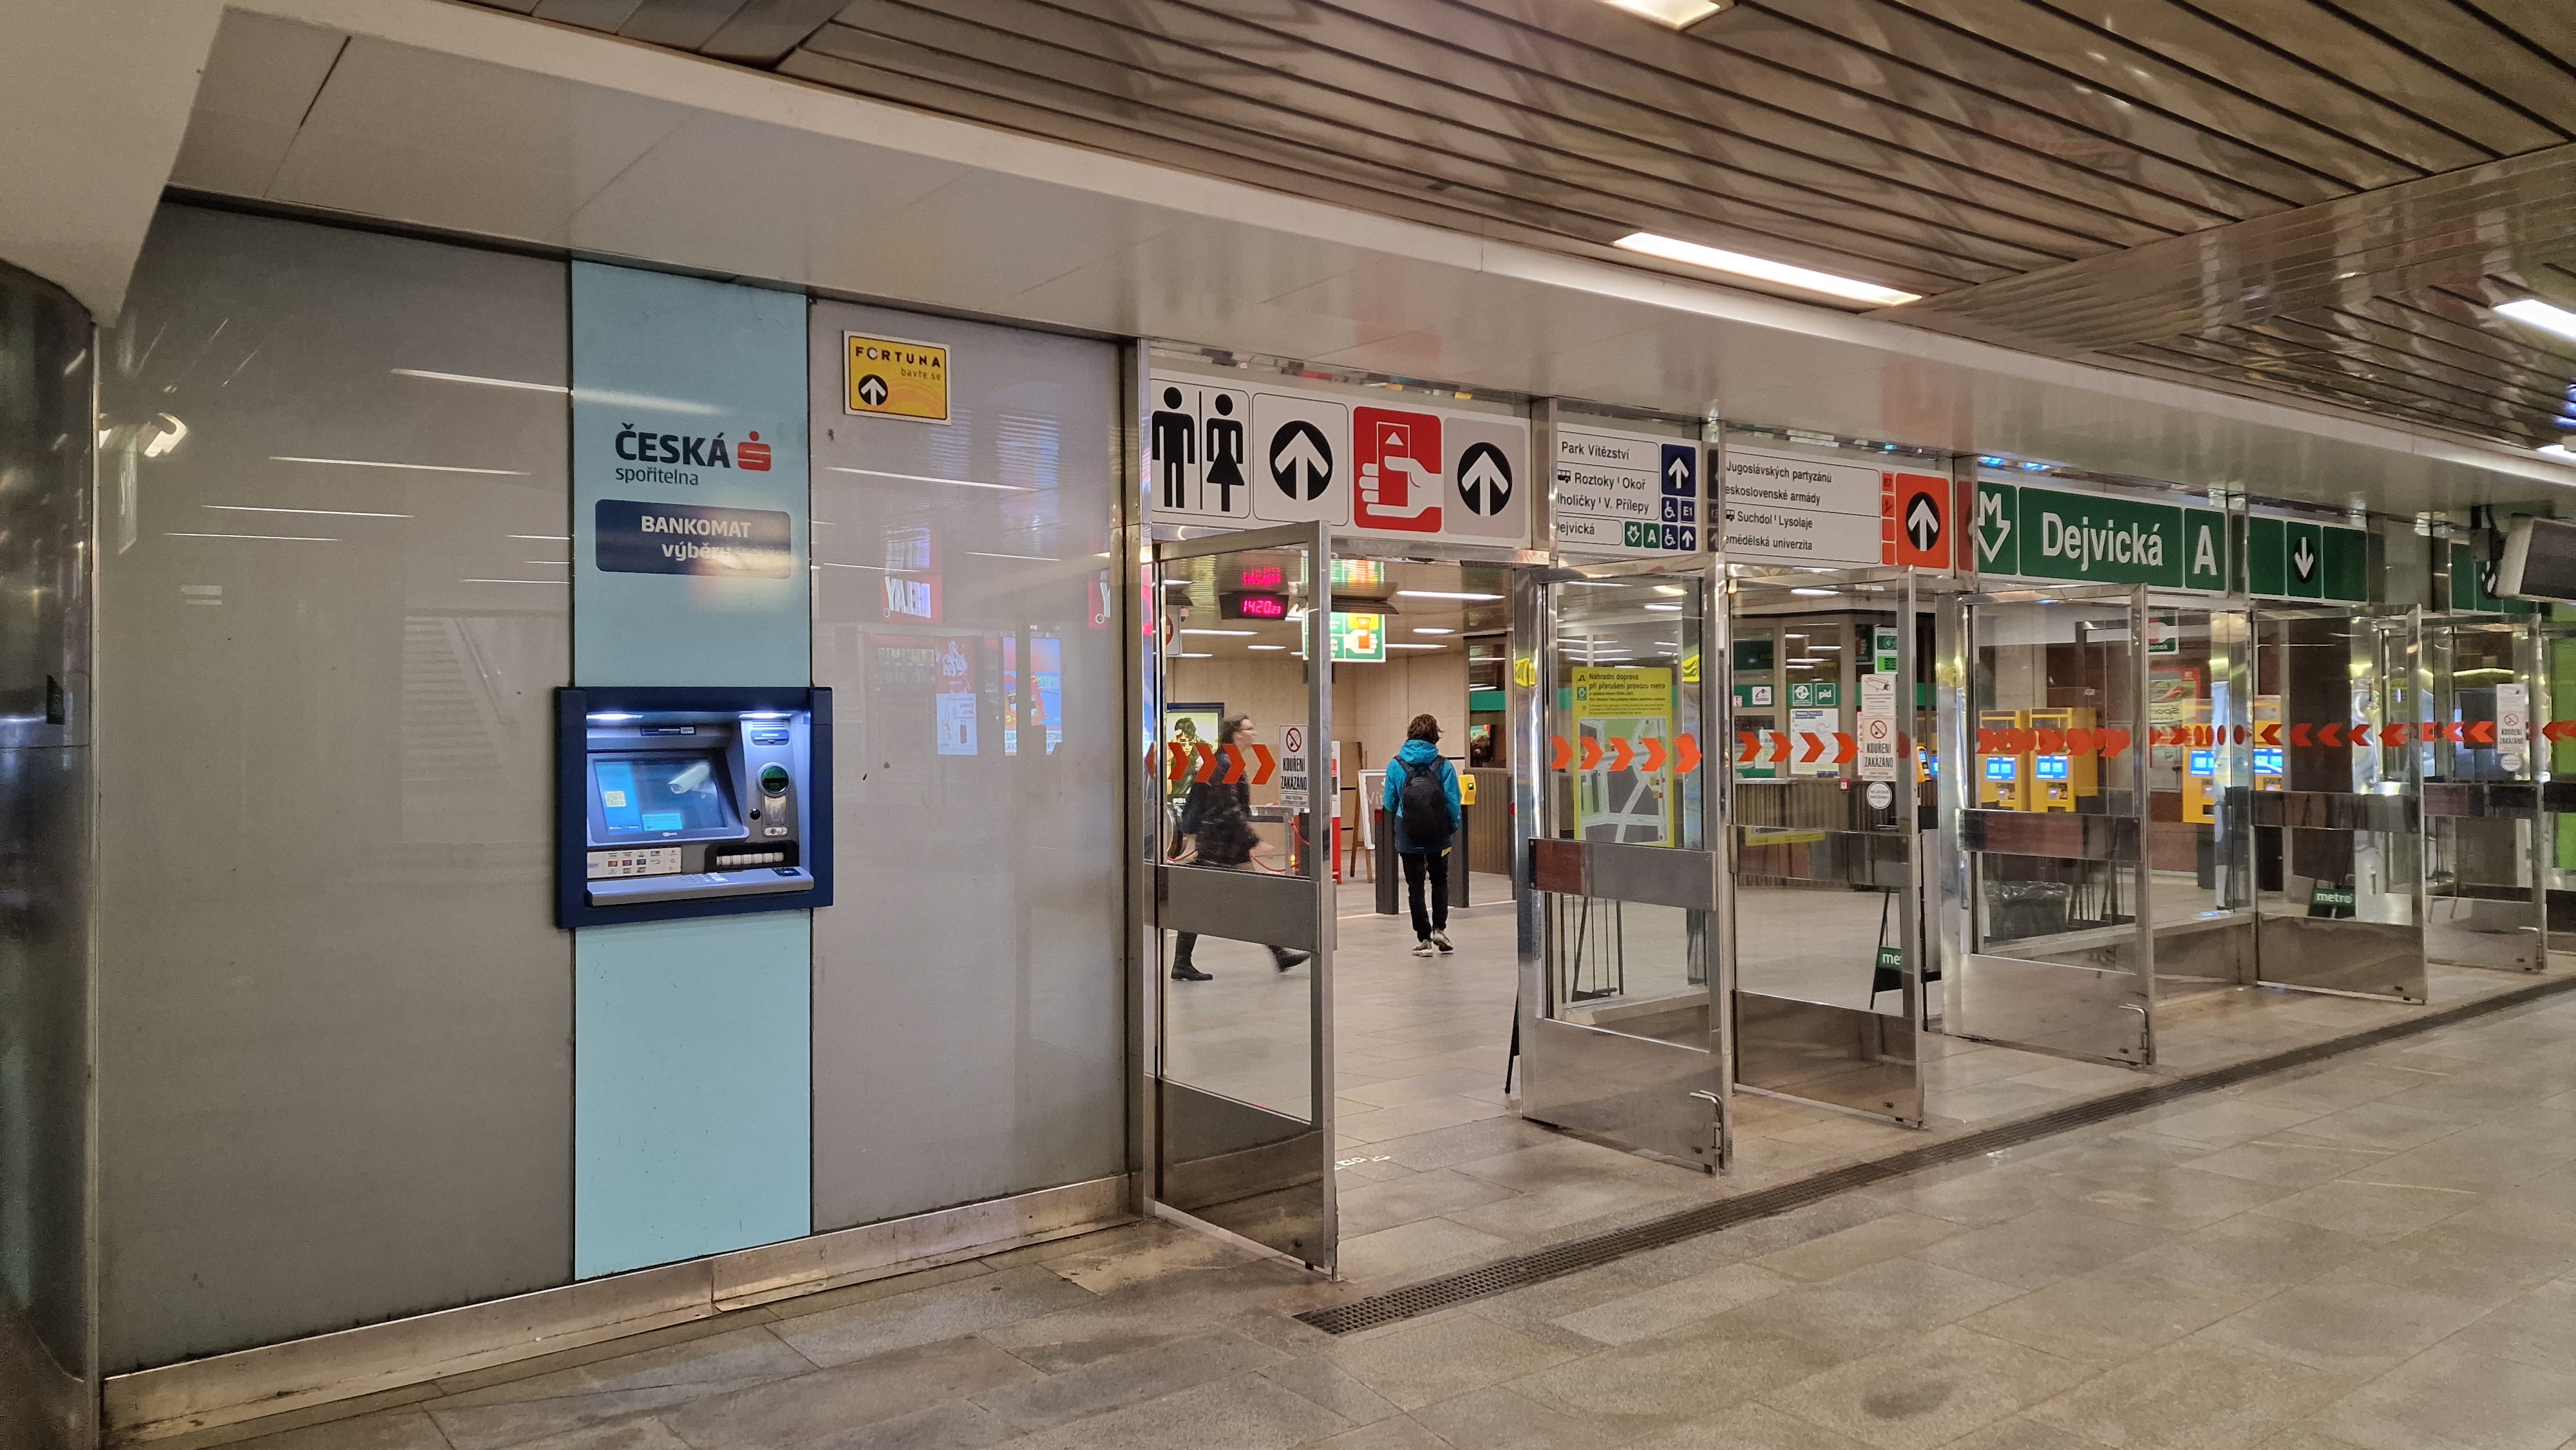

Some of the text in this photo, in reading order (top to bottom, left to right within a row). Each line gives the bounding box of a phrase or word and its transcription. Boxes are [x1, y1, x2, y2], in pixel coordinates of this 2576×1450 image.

[855, 346, 941, 368] FORTUNA
[901, 368, 941, 381] bavte se
[615, 422, 730, 468] ČESKÁ
[1562, 441, 1629, 460] Park Vítězství
[616, 467, 699, 485] spořitelna
[1575, 472, 1646, 490] Roztoky Okoř
[1727, 460, 1832, 484] Jugoslávských partyzánů
[1557, 493, 1596, 510] holičky
[1616, 499, 1649, 515] Přílepy
[1726, 486, 1821, 506] eskoslovenské armády
[1683, 507, 1693, 516] E1
[641, 516, 752, 538] BANKOMAT
[1738, 511, 1813, 531] Suchdol Lysolaje
[1557, 523, 1595, 535] ejvická
[1647, 529, 1657, 543] A
[1725, 534, 1813, 551] emědělská univerzita
[2042, 512, 2163, 571] Dejvická
[2193, 525, 2217, 576] A
[1819, 689, 1832, 699] pid
[1867, 741, 1891, 754] KOUŘENÍ
[1283, 755, 1305, 772] KOUŘENÍ
[1864, 755, 1893, 767] ZAKÁZÁNO
[1281, 774, 1307, 791] ZAKÁZÁNO
[2316, 892, 2353, 904] metro
